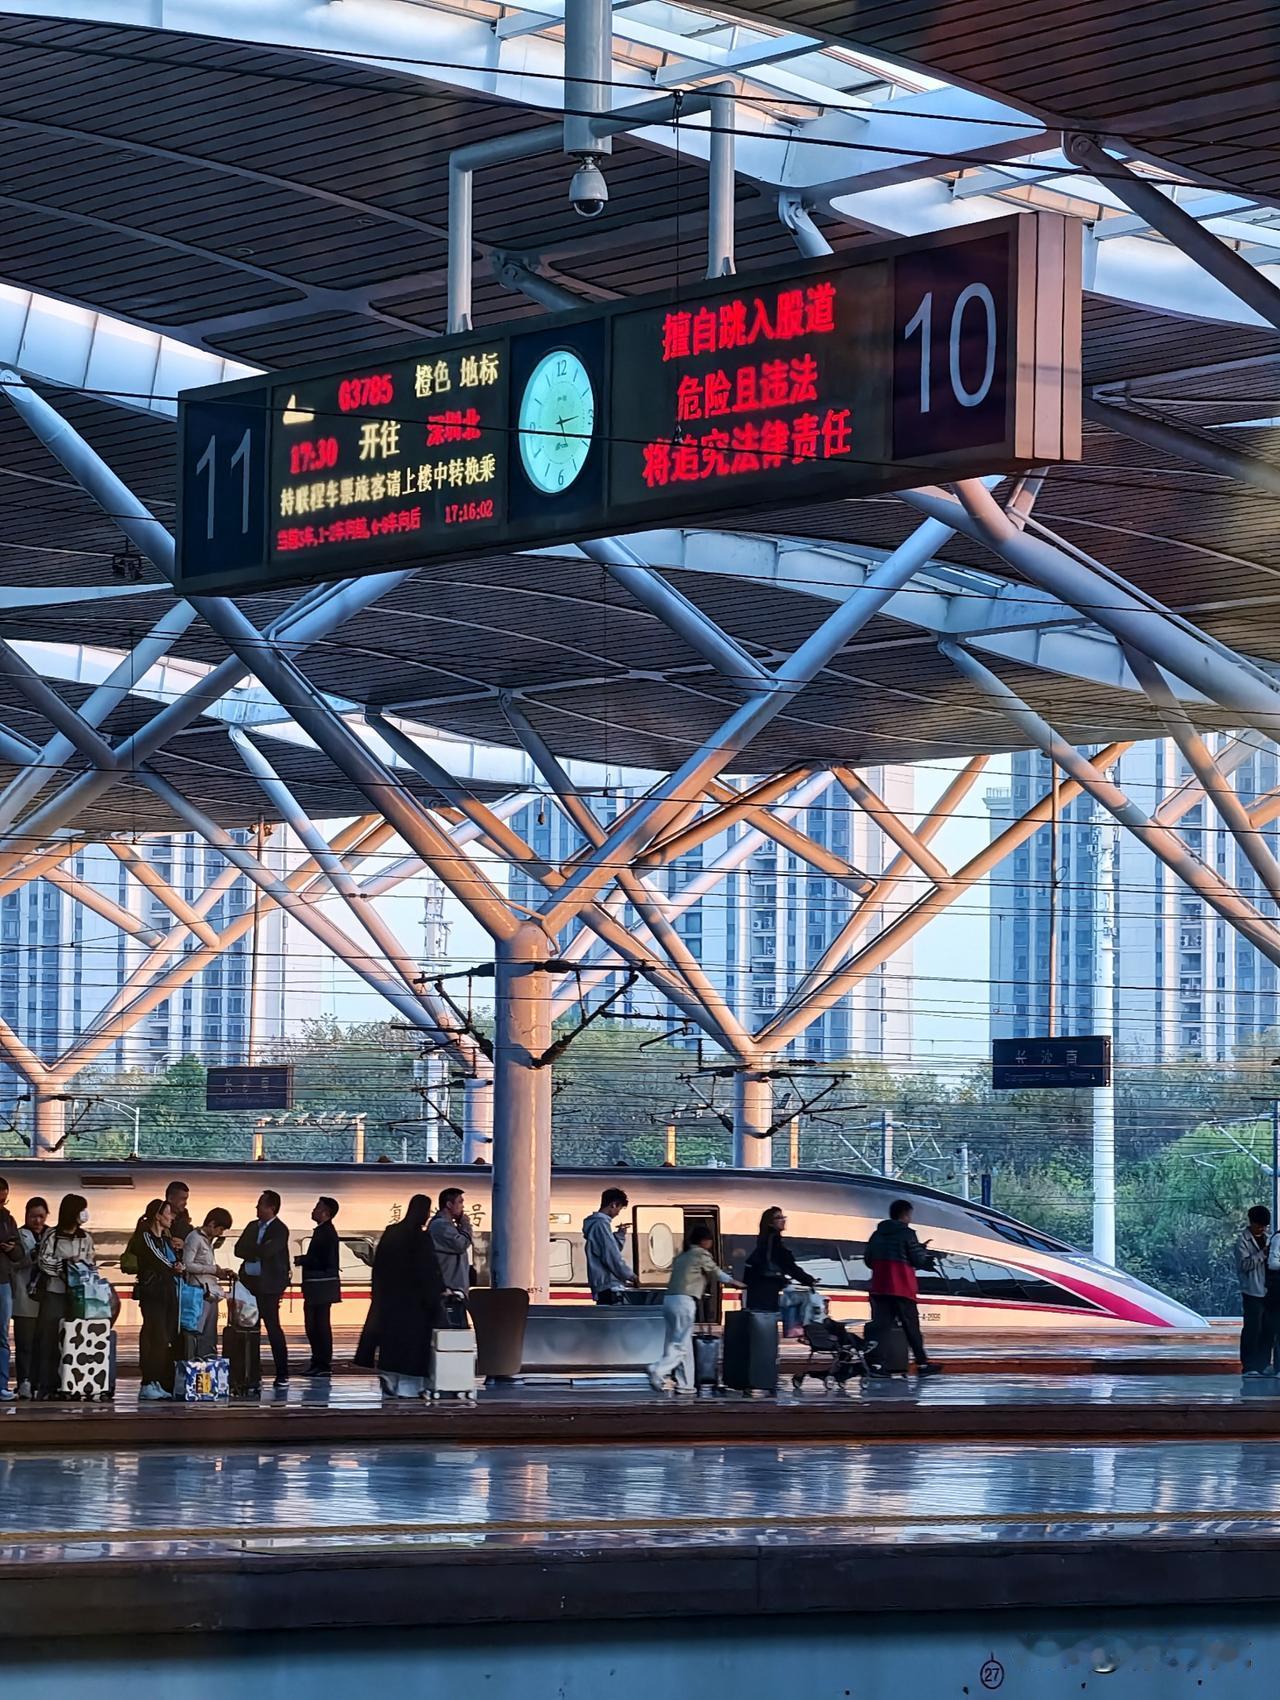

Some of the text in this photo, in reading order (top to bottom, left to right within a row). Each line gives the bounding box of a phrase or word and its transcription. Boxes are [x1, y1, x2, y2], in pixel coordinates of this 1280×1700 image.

[661, 281, 837, 363] 擅自跳入股道
[557, 359, 567, 377] 12
[905, 282, 997, 413] 10
[415, 352, 499, 398] 橙色 地标
[677, 353, 819, 422] 危险且违法
[359, 420, 401, 460] 开往
[641, 408, 853, 488] 将追究法律责任
[196, 428, 251, 539] 11
[557, 469, 564, 486] 6
[445, 499, 494, 524] 17:16:02
[984, 1667, 1000, 1683] 27
